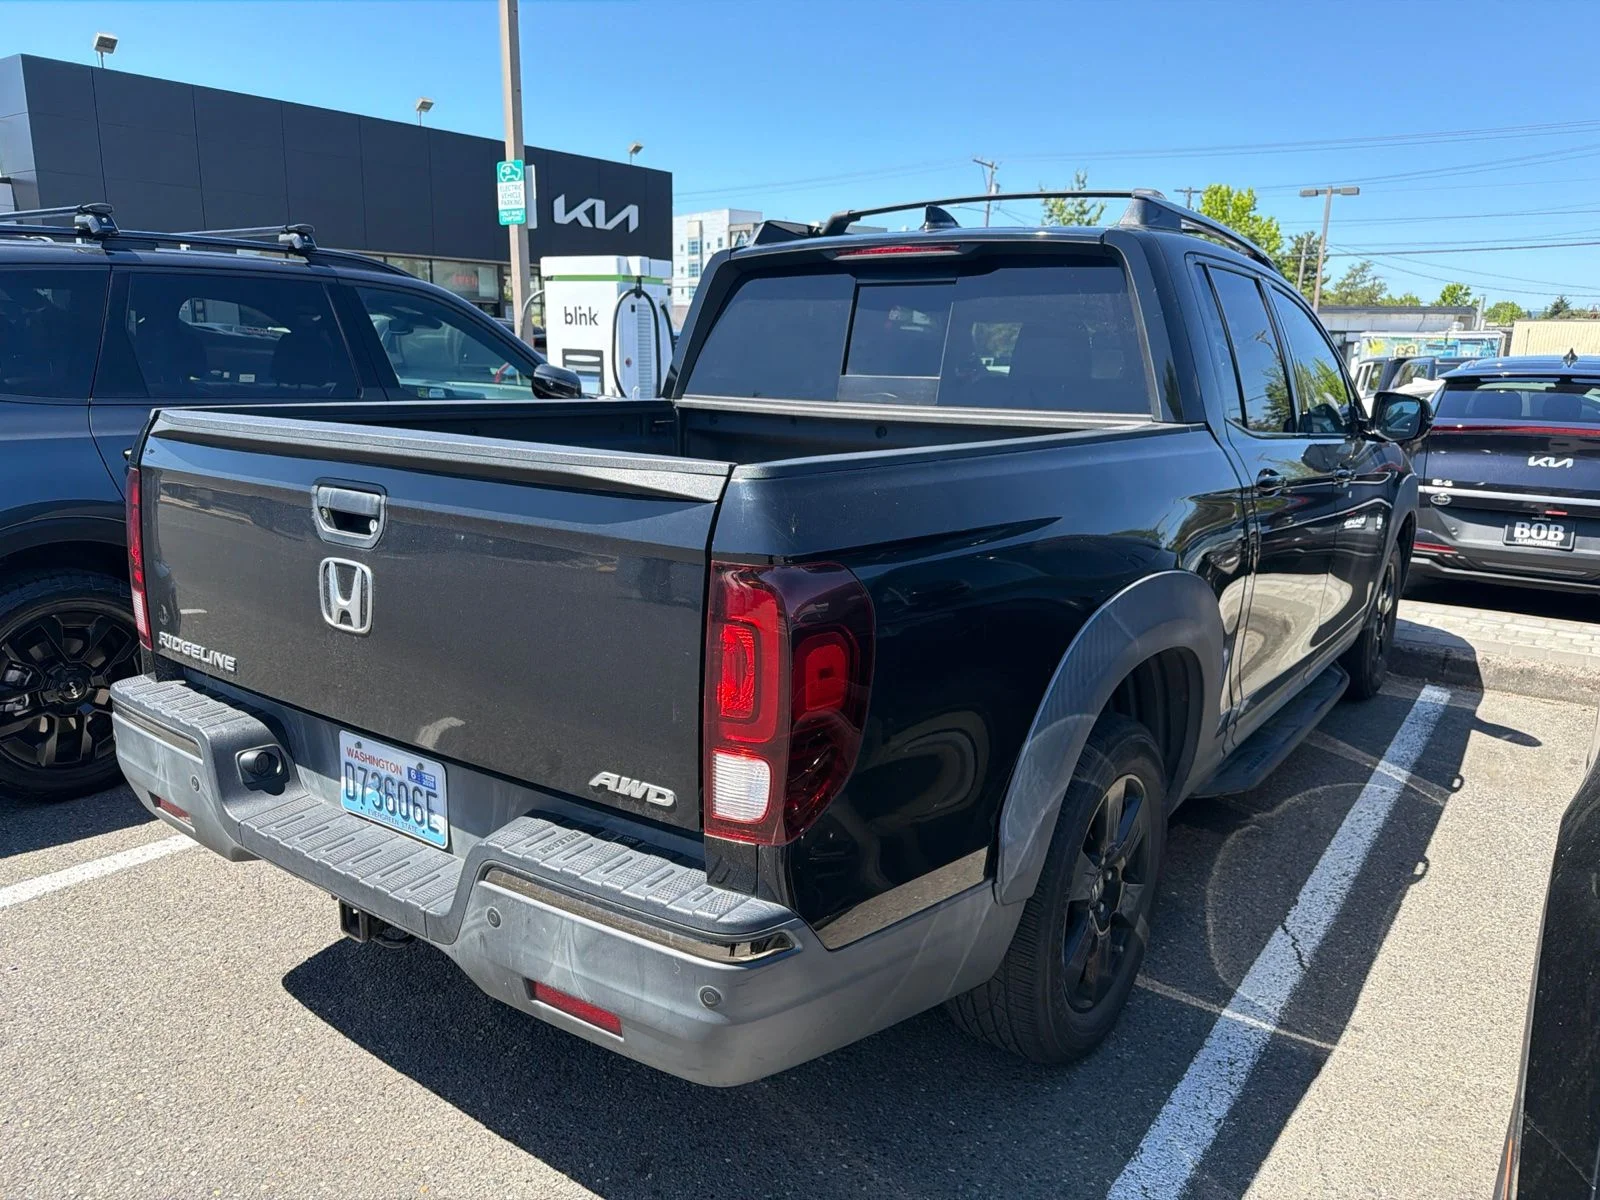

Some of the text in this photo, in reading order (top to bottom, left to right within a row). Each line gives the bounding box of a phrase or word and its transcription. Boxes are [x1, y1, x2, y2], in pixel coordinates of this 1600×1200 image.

[499, 184, 522, 192] ELECTRIC
[553, 193, 639, 233] KIA
[564, 305, 599, 326] blink
[1527, 456, 1574, 469] KIA
[1514, 521, 1565, 542] BOB
[158, 631, 238, 672] RIDGELINE
[346, 746, 402, 776] WASHINGTON
[344, 761, 440, 834] D73606E
[588, 771, 676, 807] AWD
[367, 807, 400, 826] EVERGREEN
[401, 820, 419, 833] STATE
